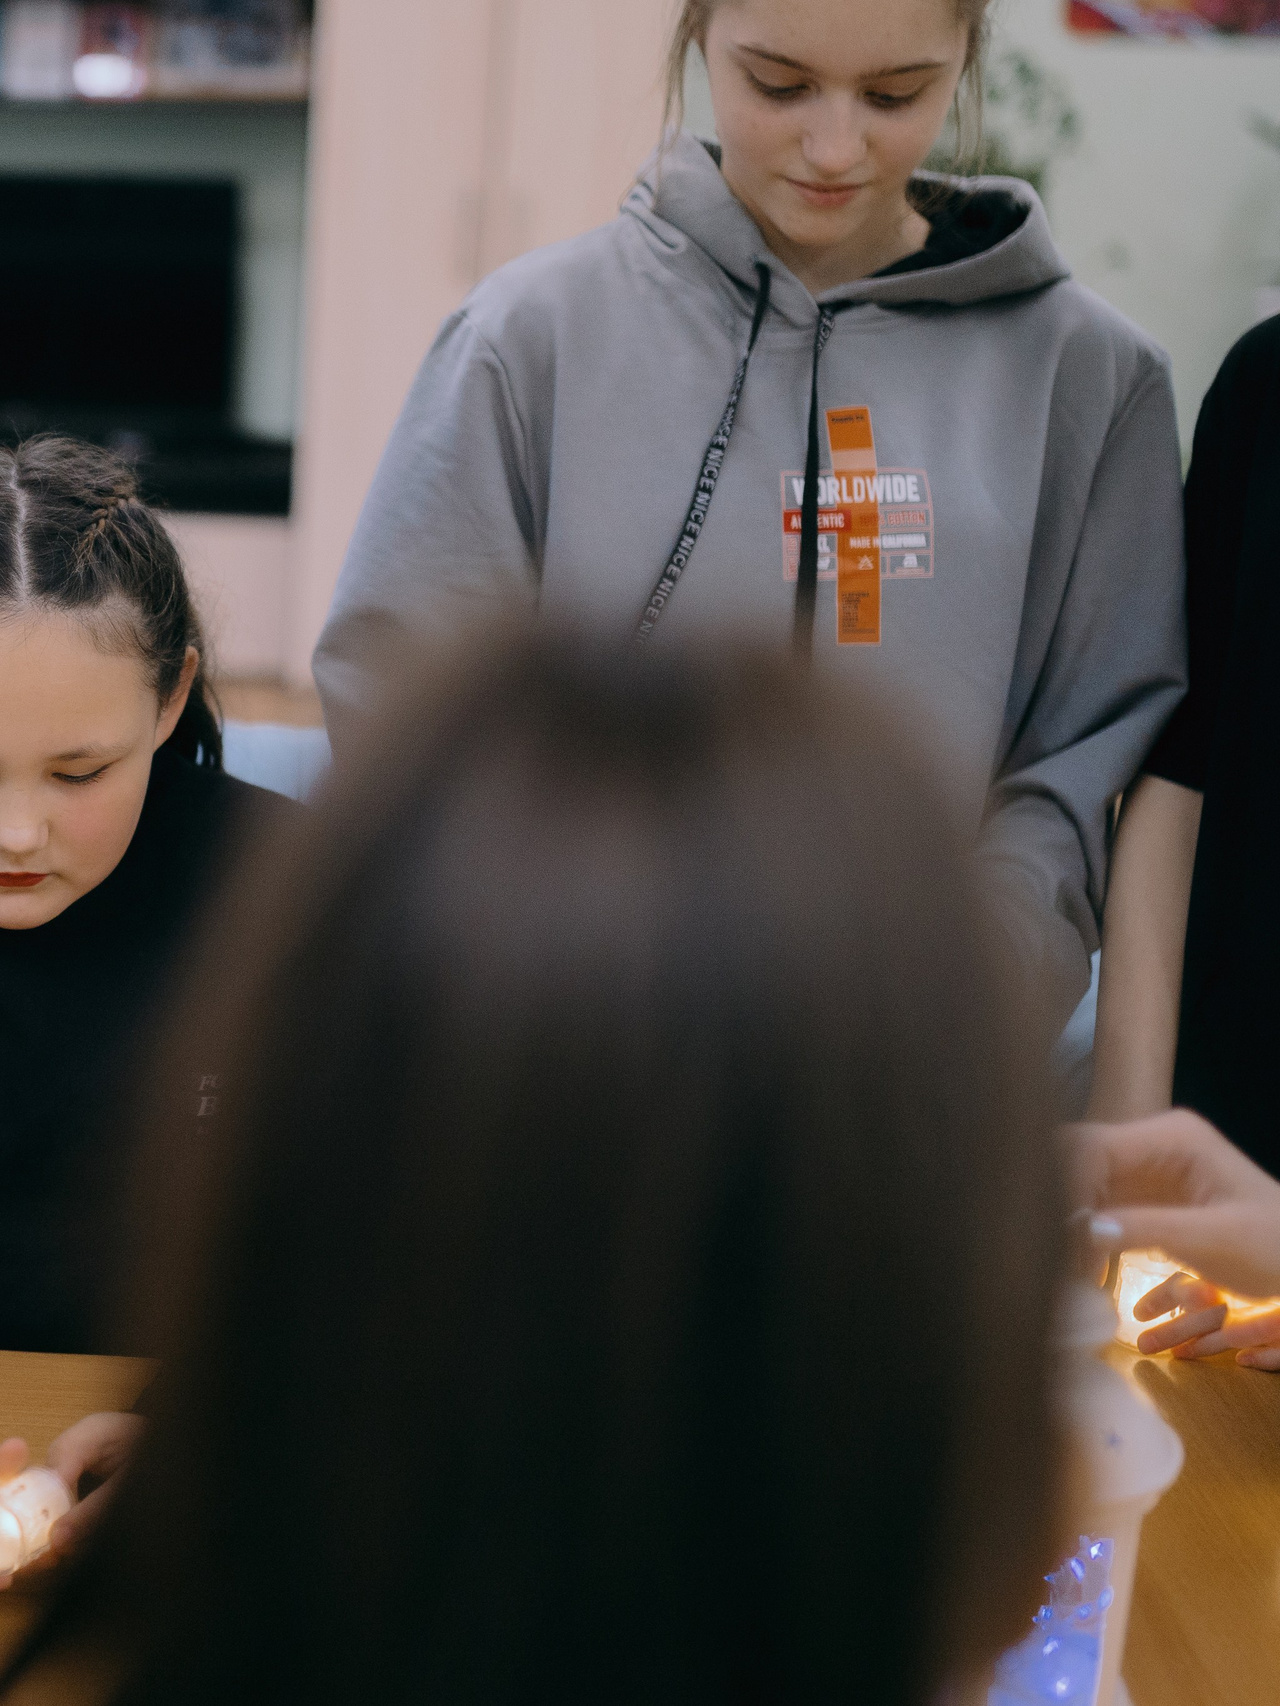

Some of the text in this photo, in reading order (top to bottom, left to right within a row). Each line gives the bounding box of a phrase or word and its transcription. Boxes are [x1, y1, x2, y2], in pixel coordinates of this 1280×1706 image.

[699, 447, 725, 491] NICE
[686, 490, 711, 536] NICE
[790, 512, 845, 530] AENTIC
[665, 534, 695, 578] NICE
[849, 536, 872, 549] MADE
[645, 577, 674, 619] NICE
